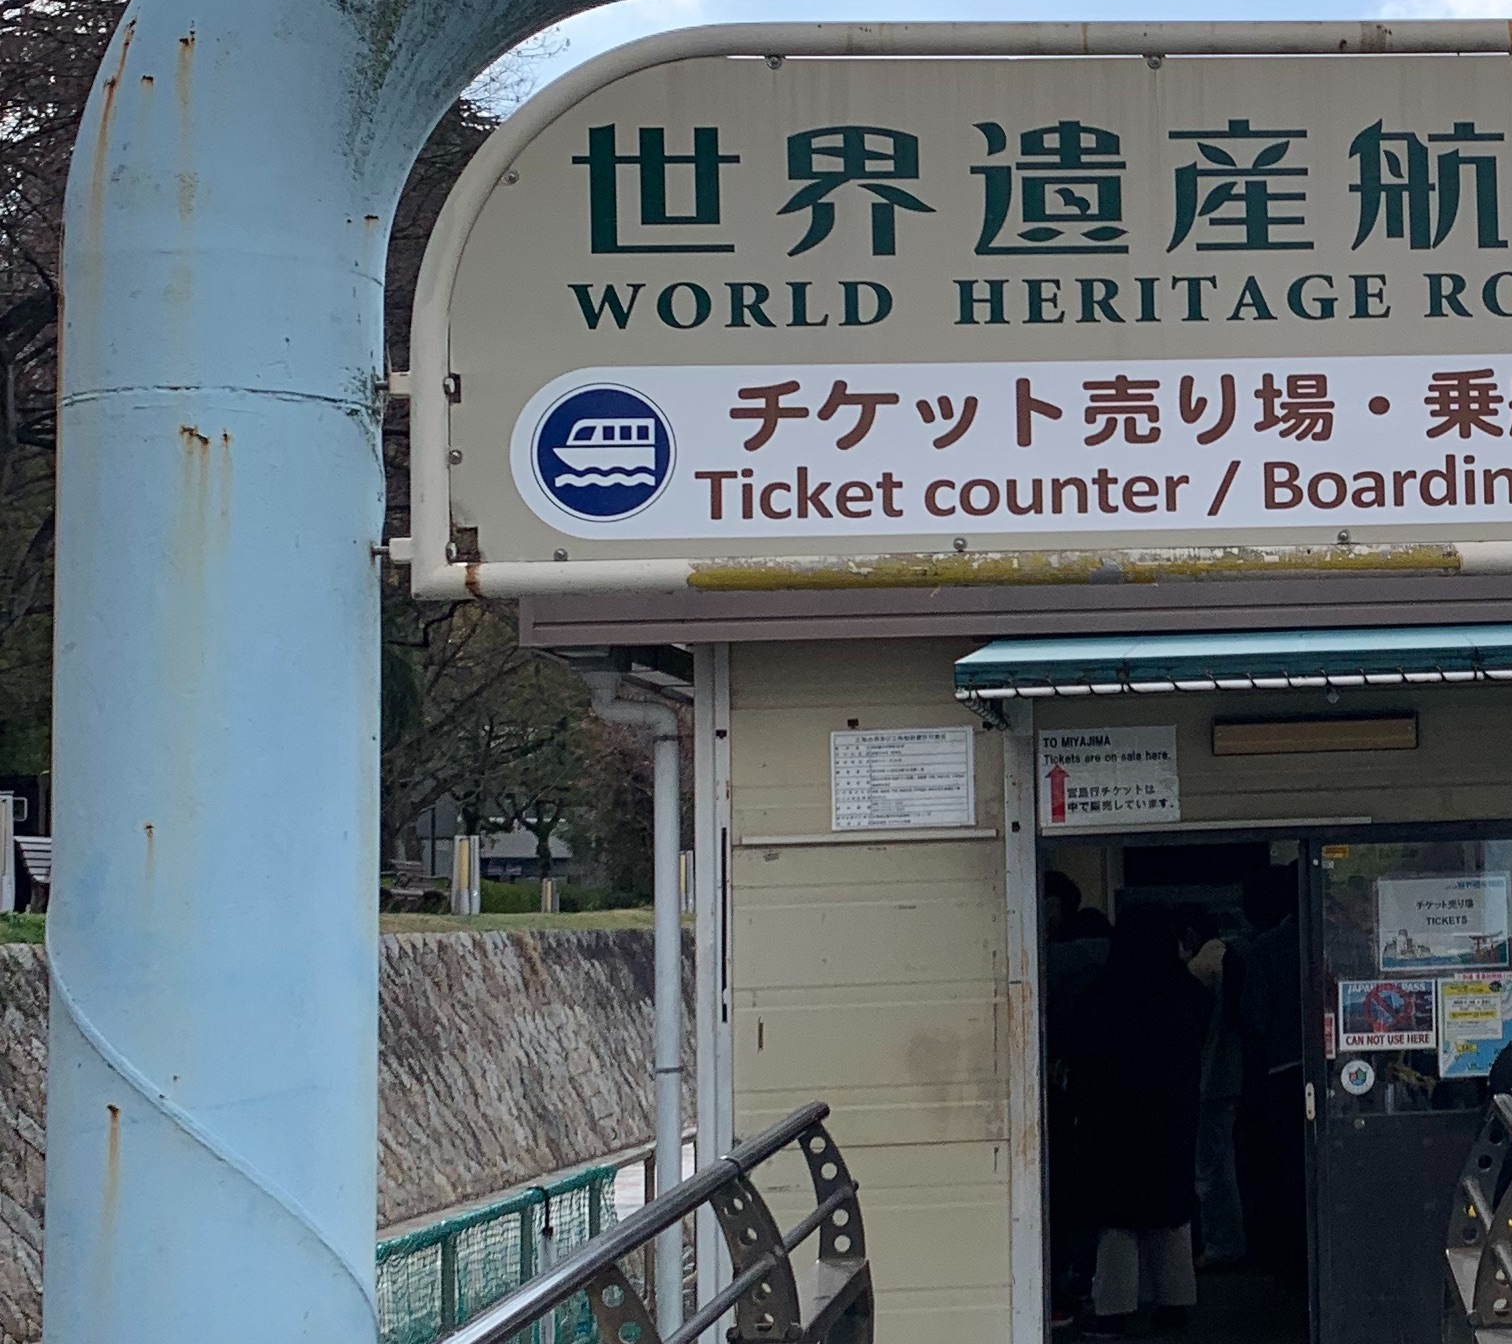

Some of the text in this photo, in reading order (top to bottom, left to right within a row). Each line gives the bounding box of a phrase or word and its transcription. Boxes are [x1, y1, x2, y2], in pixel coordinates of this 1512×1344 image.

[570, 279, 894, 332] WORLD
[954, 271, 1393, 326] HERITAGE
[695, 466, 903, 521] Ticket
[924, 467, 1190, 518] counter
[1207, 460, 1241, 517] /
[1043, 735, 1111, 748] TO MIYAJIMA
[1044, 750, 1171, 765] Tickets are on sale here.
[1426, 916, 1468, 926] TICKETS
[1345, 1033, 1430, 1046] CAN NOT USE HERE
